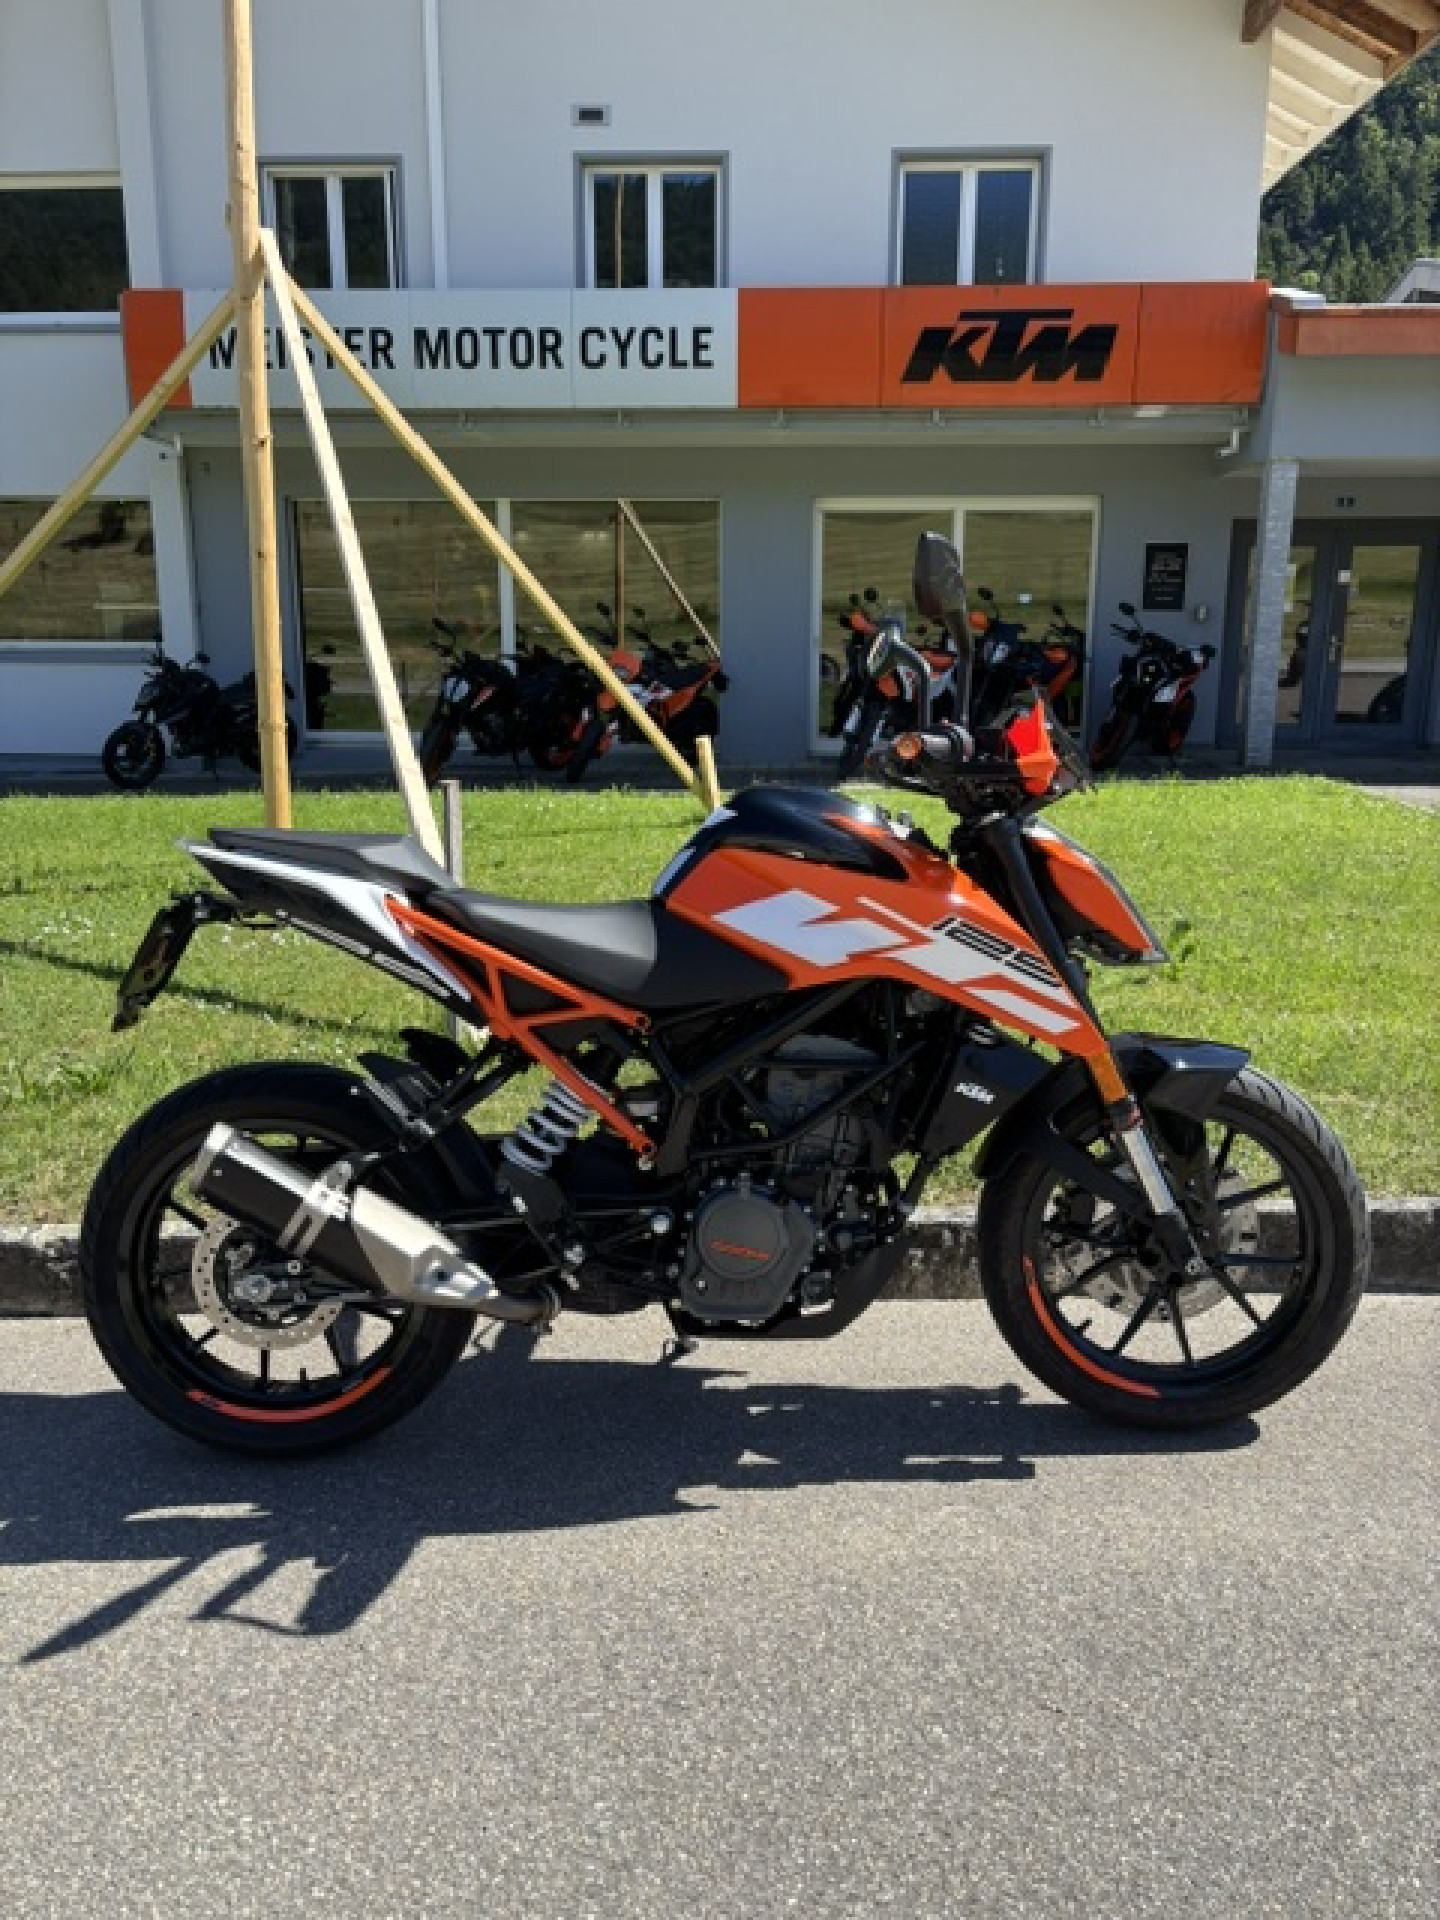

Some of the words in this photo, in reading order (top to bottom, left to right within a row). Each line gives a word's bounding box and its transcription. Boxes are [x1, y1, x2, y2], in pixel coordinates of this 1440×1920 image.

[413, 326, 564, 370] MOTOR
[578, 326, 715, 370] CYCLE
[901, 307, 1118, 383] KTM
